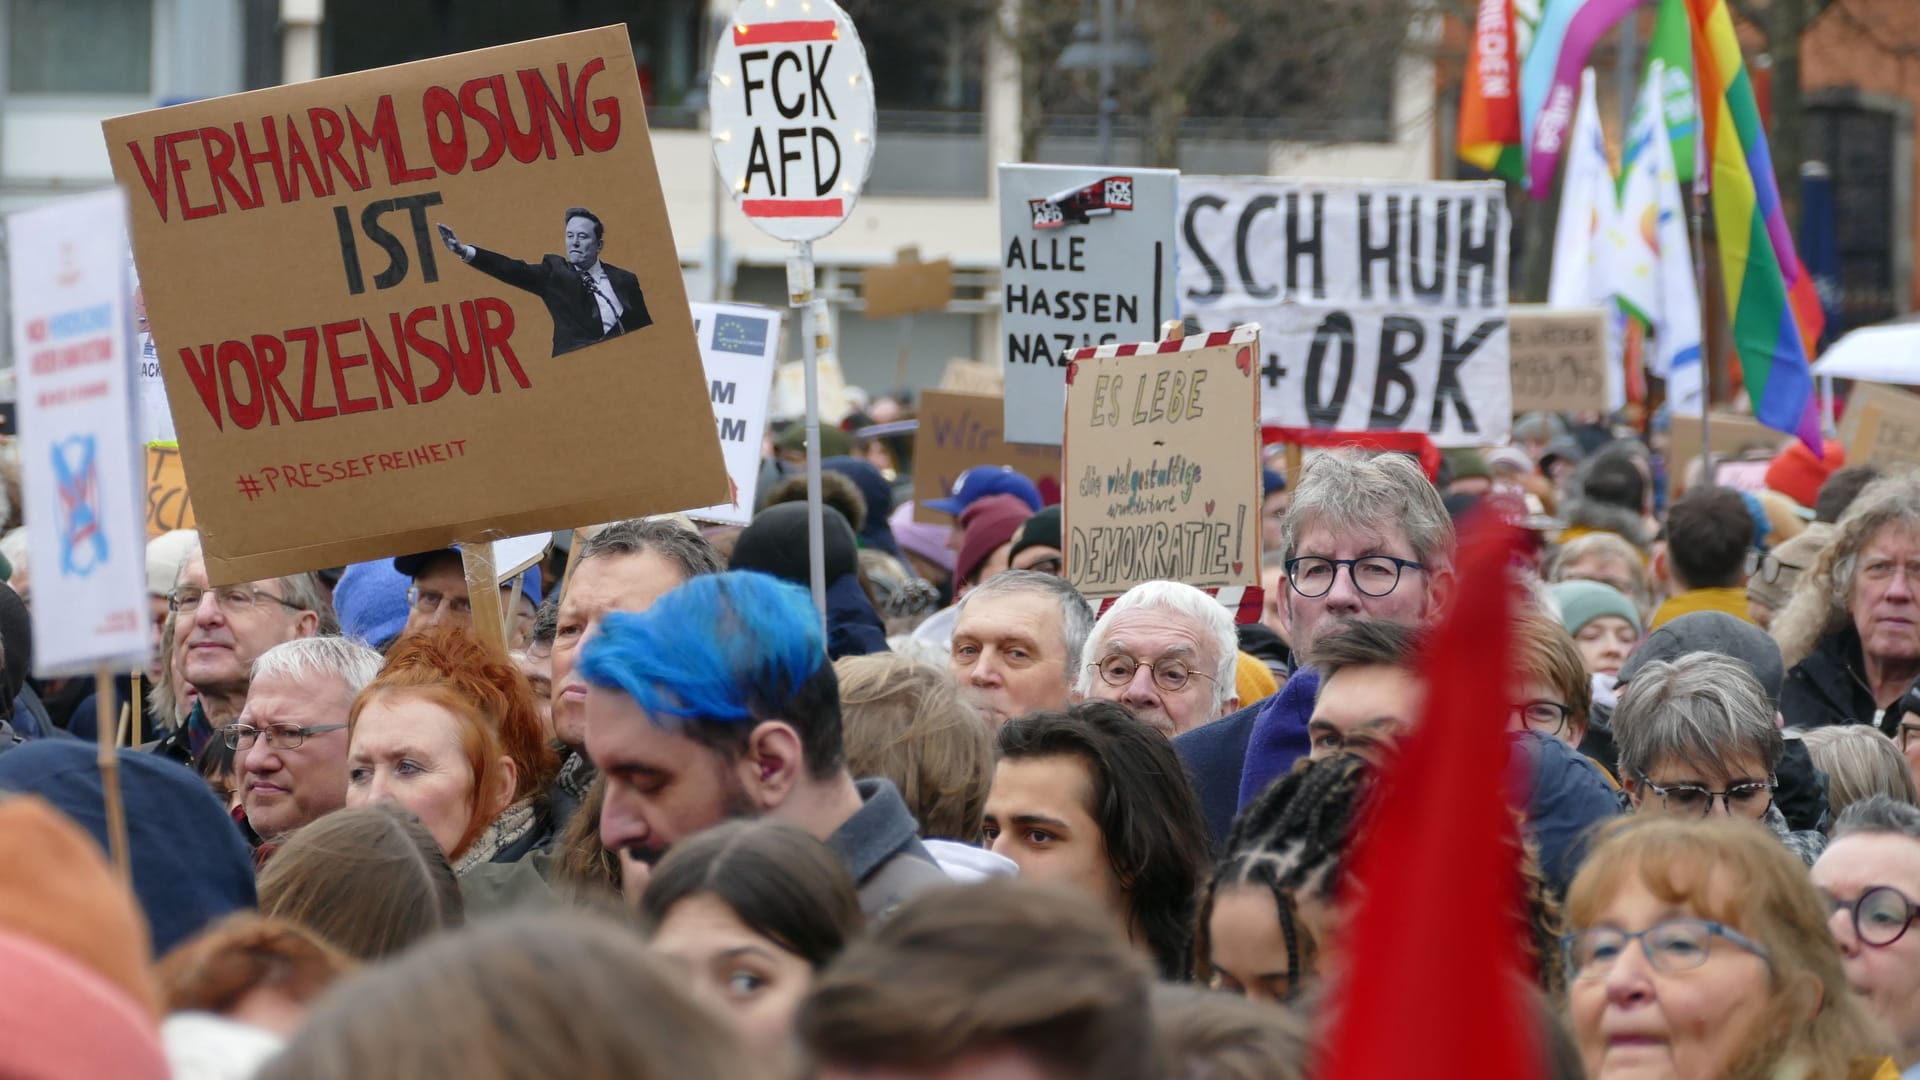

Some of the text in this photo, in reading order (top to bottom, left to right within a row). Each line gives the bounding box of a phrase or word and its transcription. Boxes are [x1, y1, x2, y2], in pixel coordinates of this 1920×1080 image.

[740, 44, 837, 120] FCK
[127, 57, 621, 224] VERHARMLOSUNG
[742, 126, 841, 197] AFD
[1034, 211, 1064, 225] AFD
[1104, 180, 1132, 194] FCK
[1104, 192, 1132, 206] NZS
[333, 191, 443, 295] IST
[1006, 235, 1086, 272] ALLE
[1357, 194, 1499, 308] HUH
[1006, 284, 1138, 324] HASSEN
[179, 297, 532, 433] VORZENSUR
[1090, 369, 1208, 427] ES LEBE
[1304, 310, 1506, 434] OBK
[237, 438, 467, 501] #PRESSEFREIHEIT
[1070, 503, 1247, 587] DEMOKRATIE!
